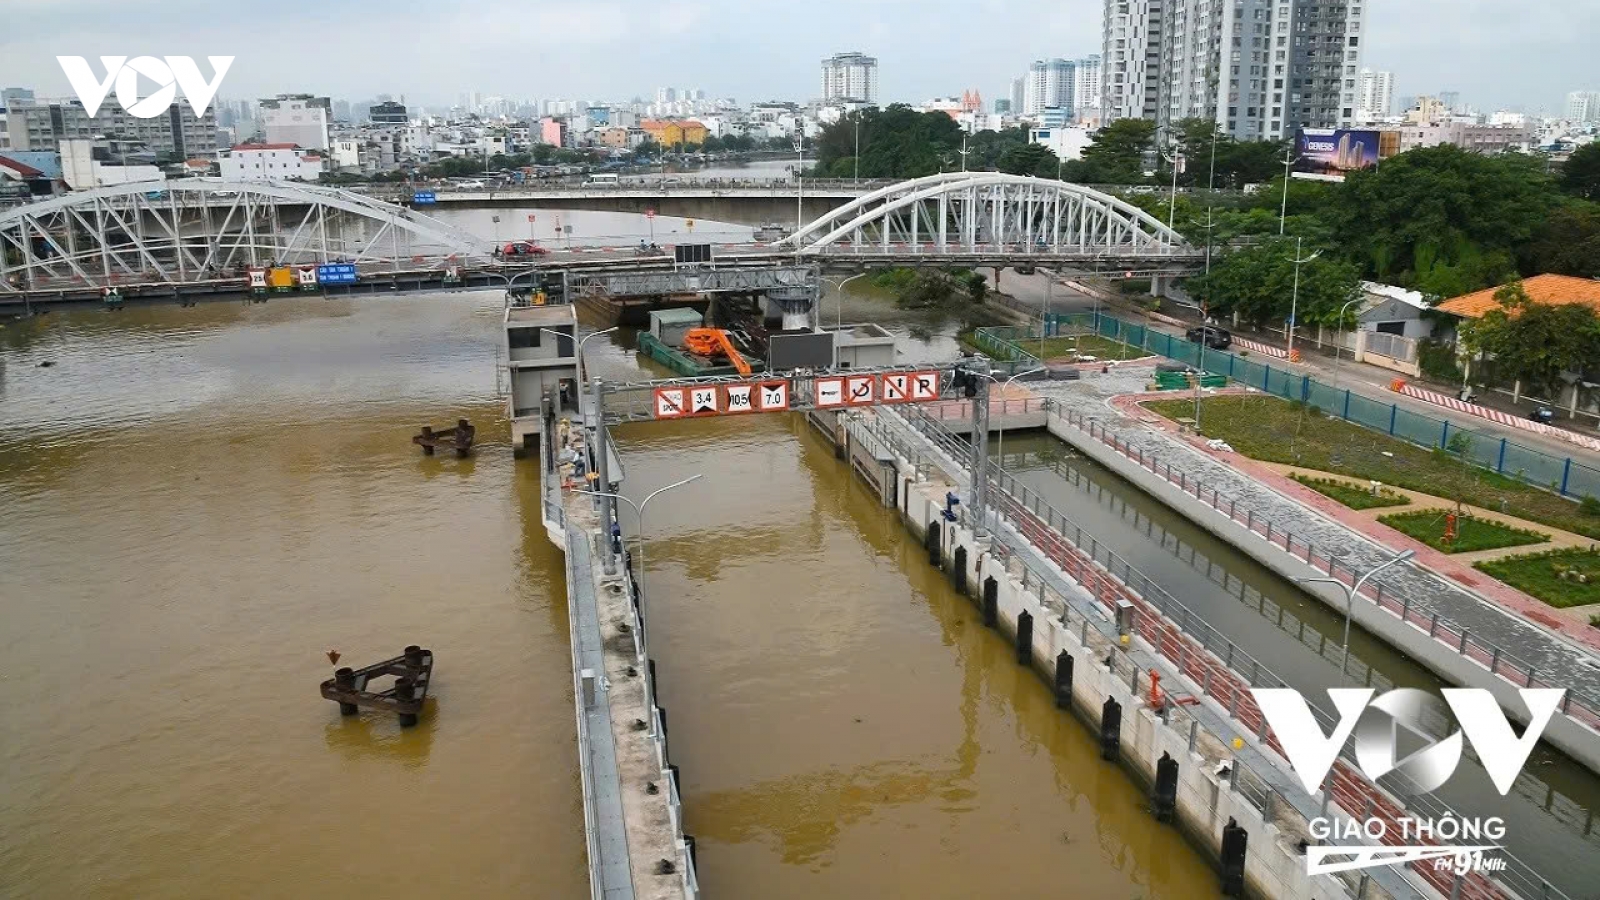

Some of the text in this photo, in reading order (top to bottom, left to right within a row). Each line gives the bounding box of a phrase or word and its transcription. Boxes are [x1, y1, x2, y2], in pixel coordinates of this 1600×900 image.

[1308, 141, 1335, 151] GENESIS
[919, 379, 930, 393] R
[696, 392, 711, 404] 3.4
[765, 392, 781, 405] 7.0
